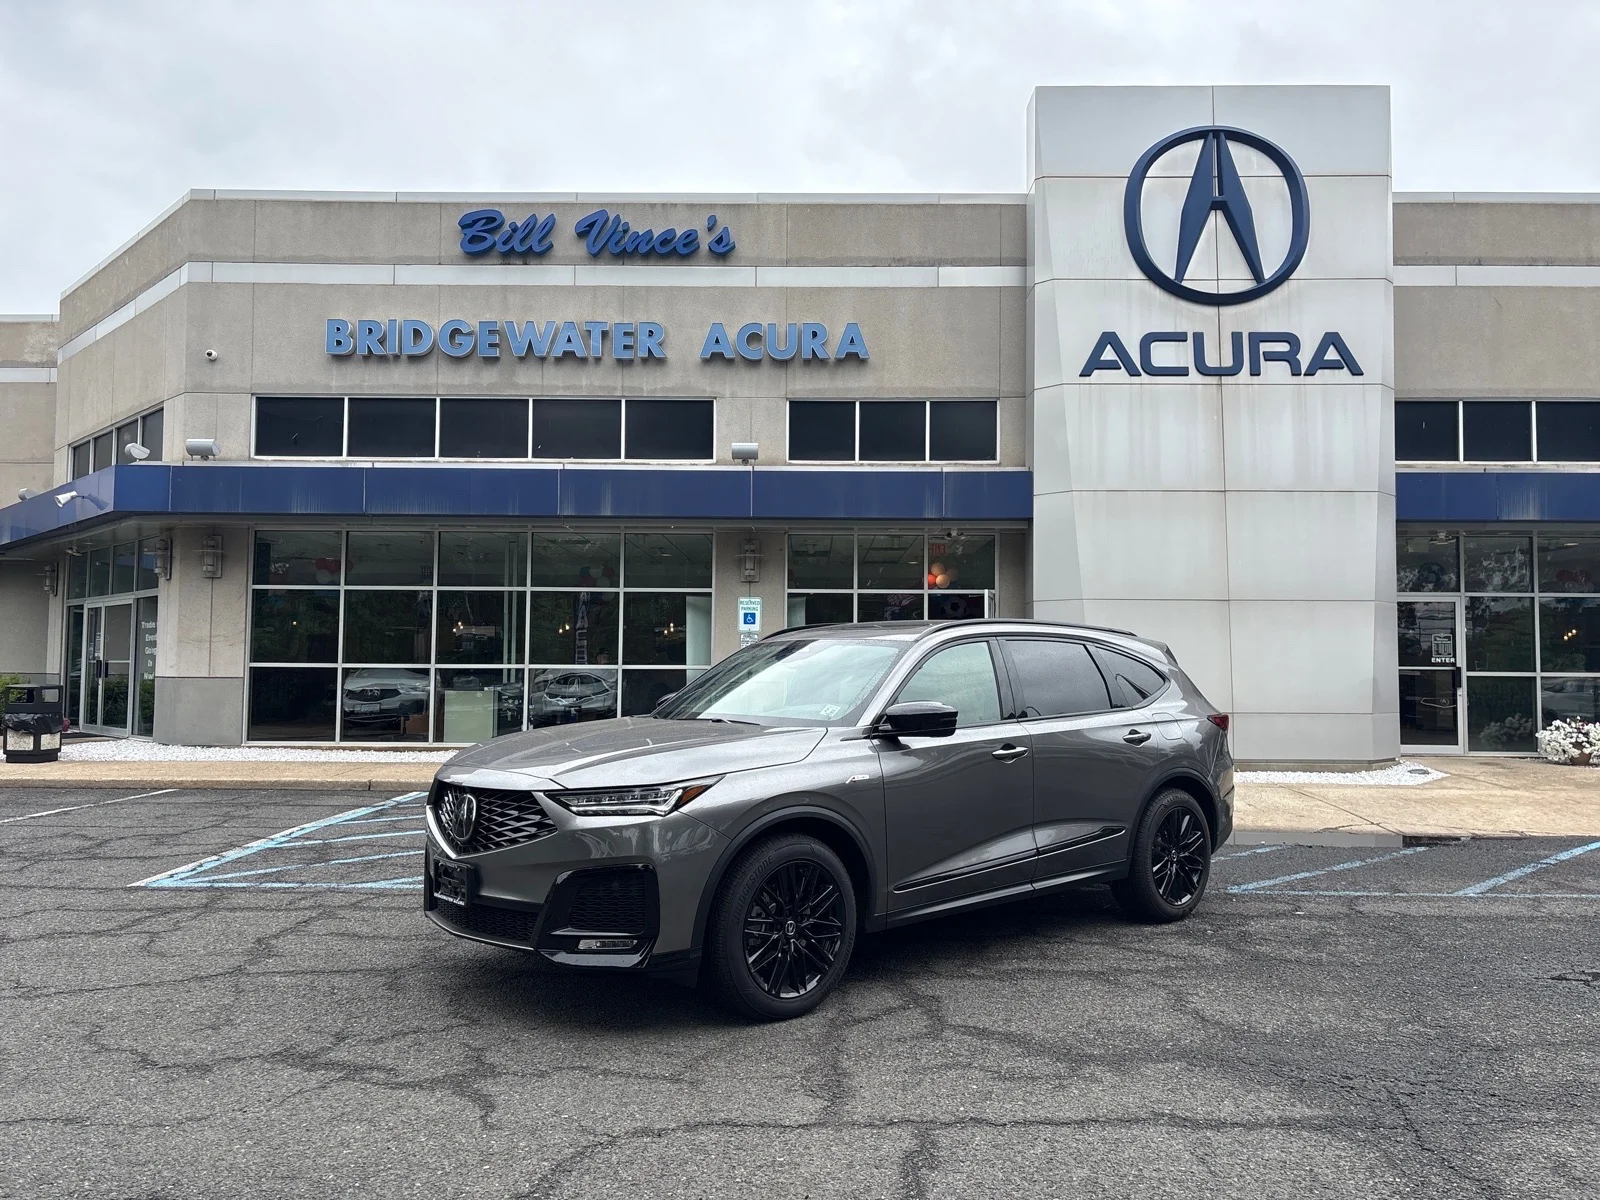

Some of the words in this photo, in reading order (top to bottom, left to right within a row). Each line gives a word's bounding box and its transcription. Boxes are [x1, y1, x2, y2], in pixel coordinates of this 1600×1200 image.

[458, 208, 556, 255] Bill
[574, 208, 736, 257] Vince's
[325, 319, 668, 360] BRIDGEWATER
[700, 322, 870, 361] ACURA
[1079, 331, 1364, 377] ACURA
[141, 621, 156, 629] Trade
